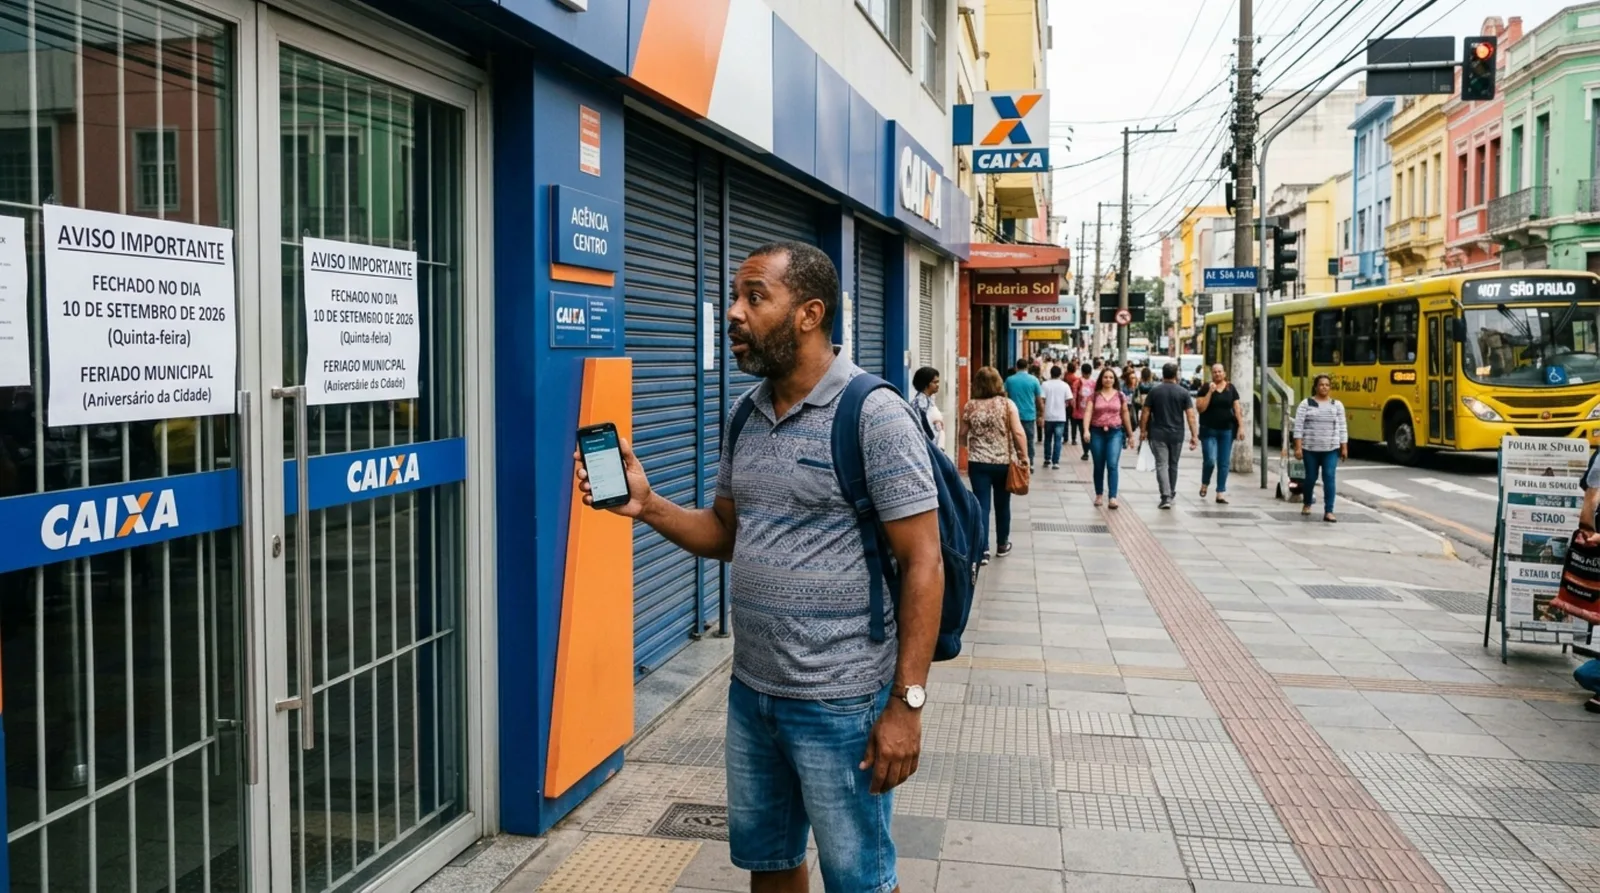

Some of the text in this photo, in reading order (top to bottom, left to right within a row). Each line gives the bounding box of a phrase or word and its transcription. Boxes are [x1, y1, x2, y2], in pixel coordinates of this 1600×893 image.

[977, 152, 1043, 168] CAIXA
[900, 146, 942, 229] CAIXA
[58, 225, 224, 260] AVISO IMPORTANTE
[573, 233, 608, 255] CENTRO
[311, 251, 412, 277] AVISO IMPORTANTE
[93, 275, 201, 297] FECHADO NO DIA
[977, 283, 1055, 295] Padaria Sol
[1536, 282, 1576, 296] PAULO
[371, 292, 383, 305] NO
[385, 293, 398, 305] DIA
[63, 300, 225, 322] 10 DE SETEMBRO DE 2026
[314, 309, 324, 322] 10
[327, 309, 337, 322] DE
[396, 313, 414, 325] 2026
[108, 327, 191, 348] (Quinta-feira)
[81, 364, 213, 383] FERIADO MUNICIPAL
[1362, 377, 1378, 392] 407
[83, 387, 212, 411] (Aniversário da Cidade)
[346, 452, 420, 493] CAIXA
[40, 488, 179, 551] CAIXA
